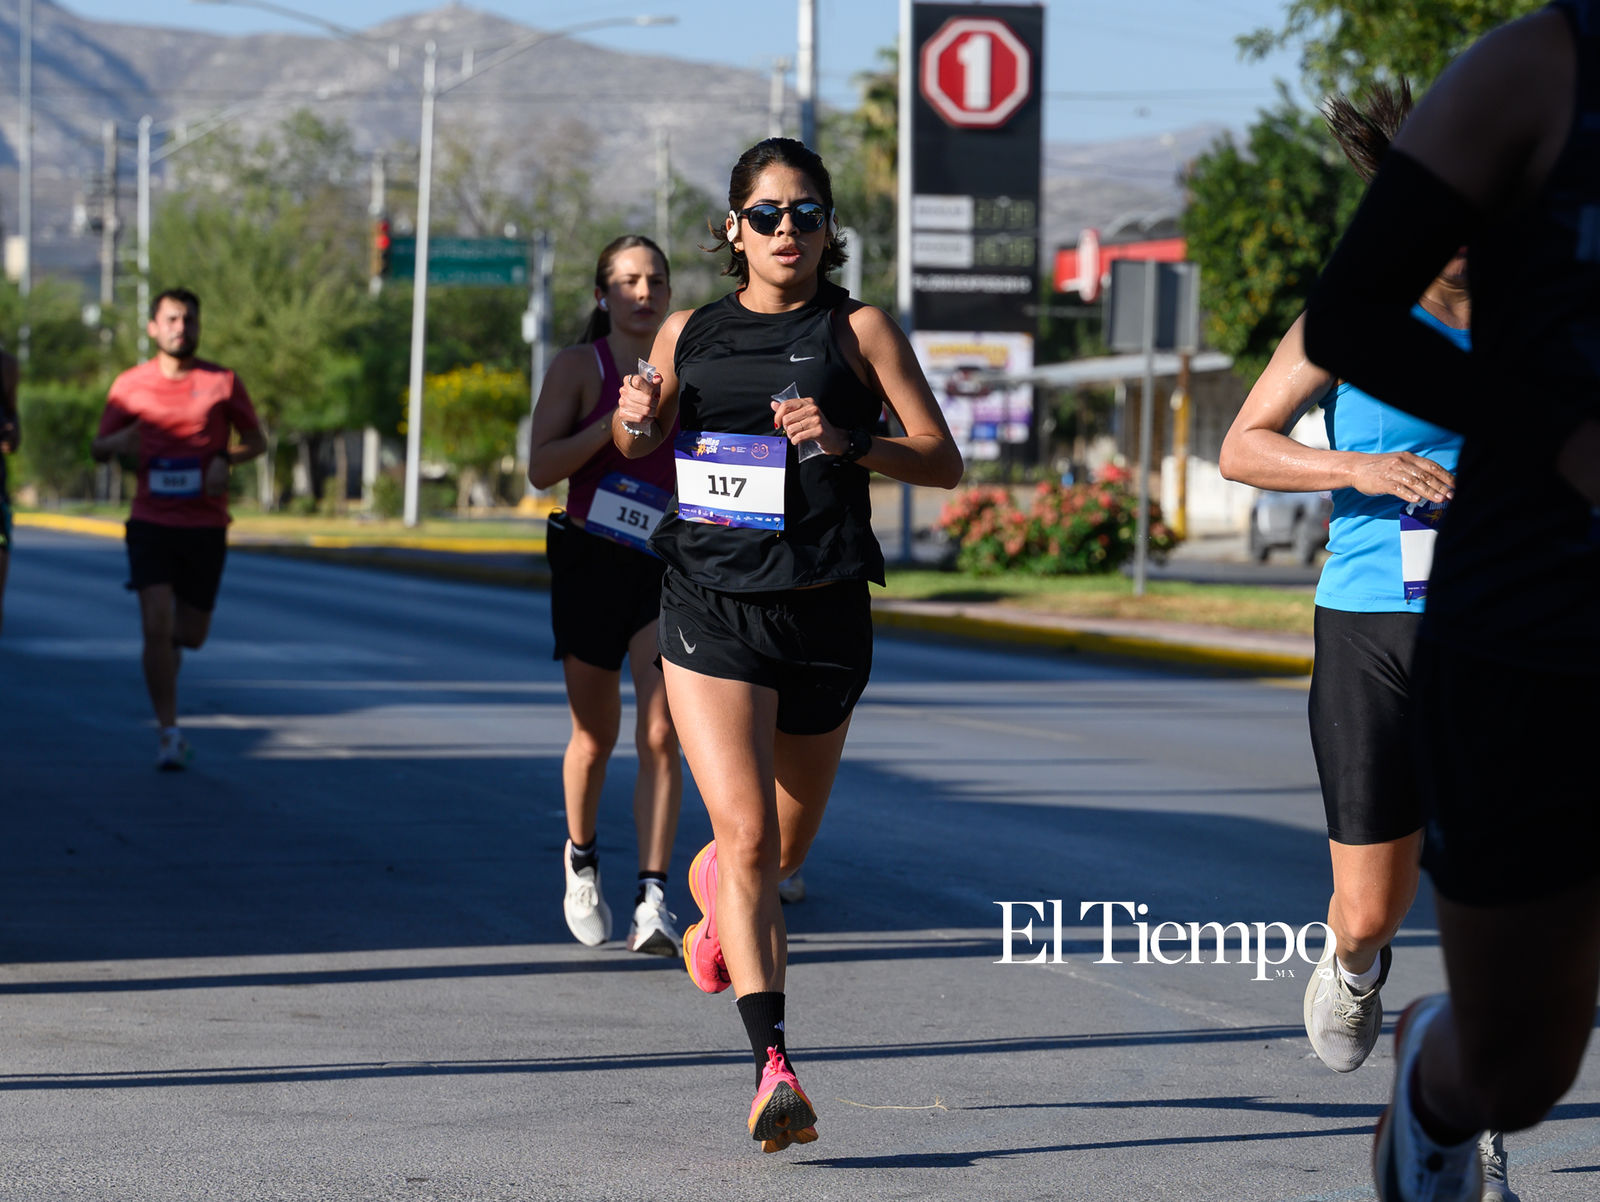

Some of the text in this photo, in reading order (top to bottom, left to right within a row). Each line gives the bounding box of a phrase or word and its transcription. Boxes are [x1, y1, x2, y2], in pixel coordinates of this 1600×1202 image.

[958, 33, 991, 110] 1
[707, 474, 747, 498] 117
[616, 506, 650, 531] 151
